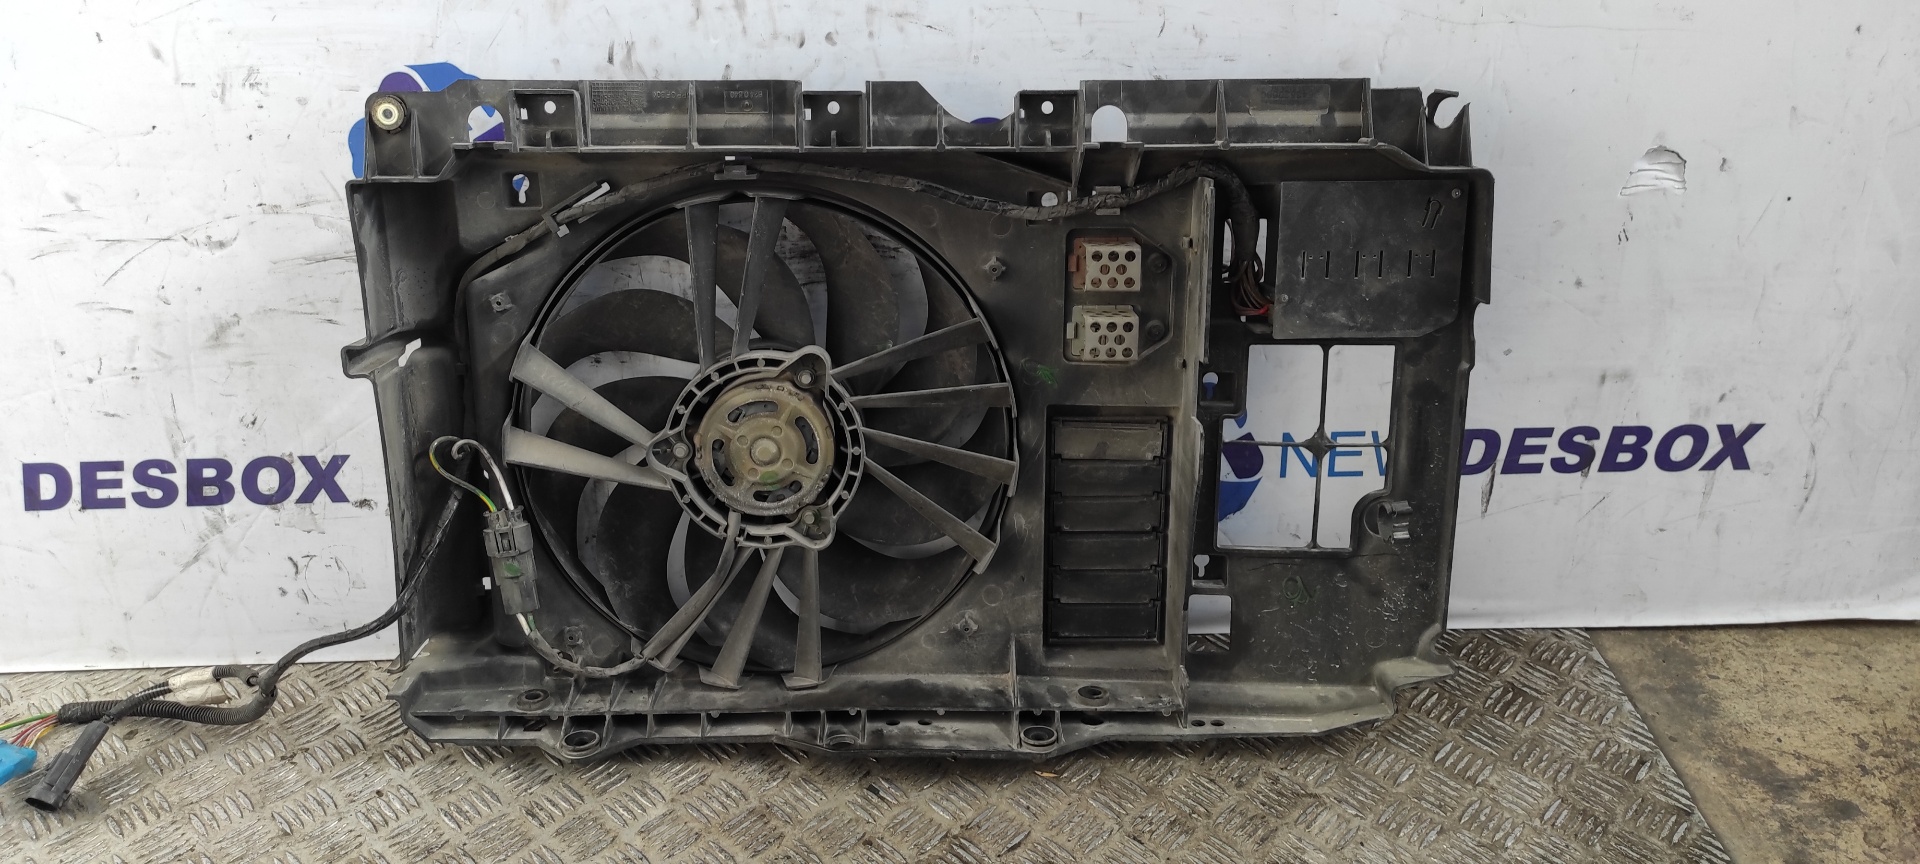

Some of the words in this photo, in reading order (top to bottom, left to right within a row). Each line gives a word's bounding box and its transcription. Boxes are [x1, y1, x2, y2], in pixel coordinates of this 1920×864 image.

[1279, 430, 1388, 479] NE
[1460, 422, 1766, 476] DESBOX
[22, 454, 351, 512] DESBOX
